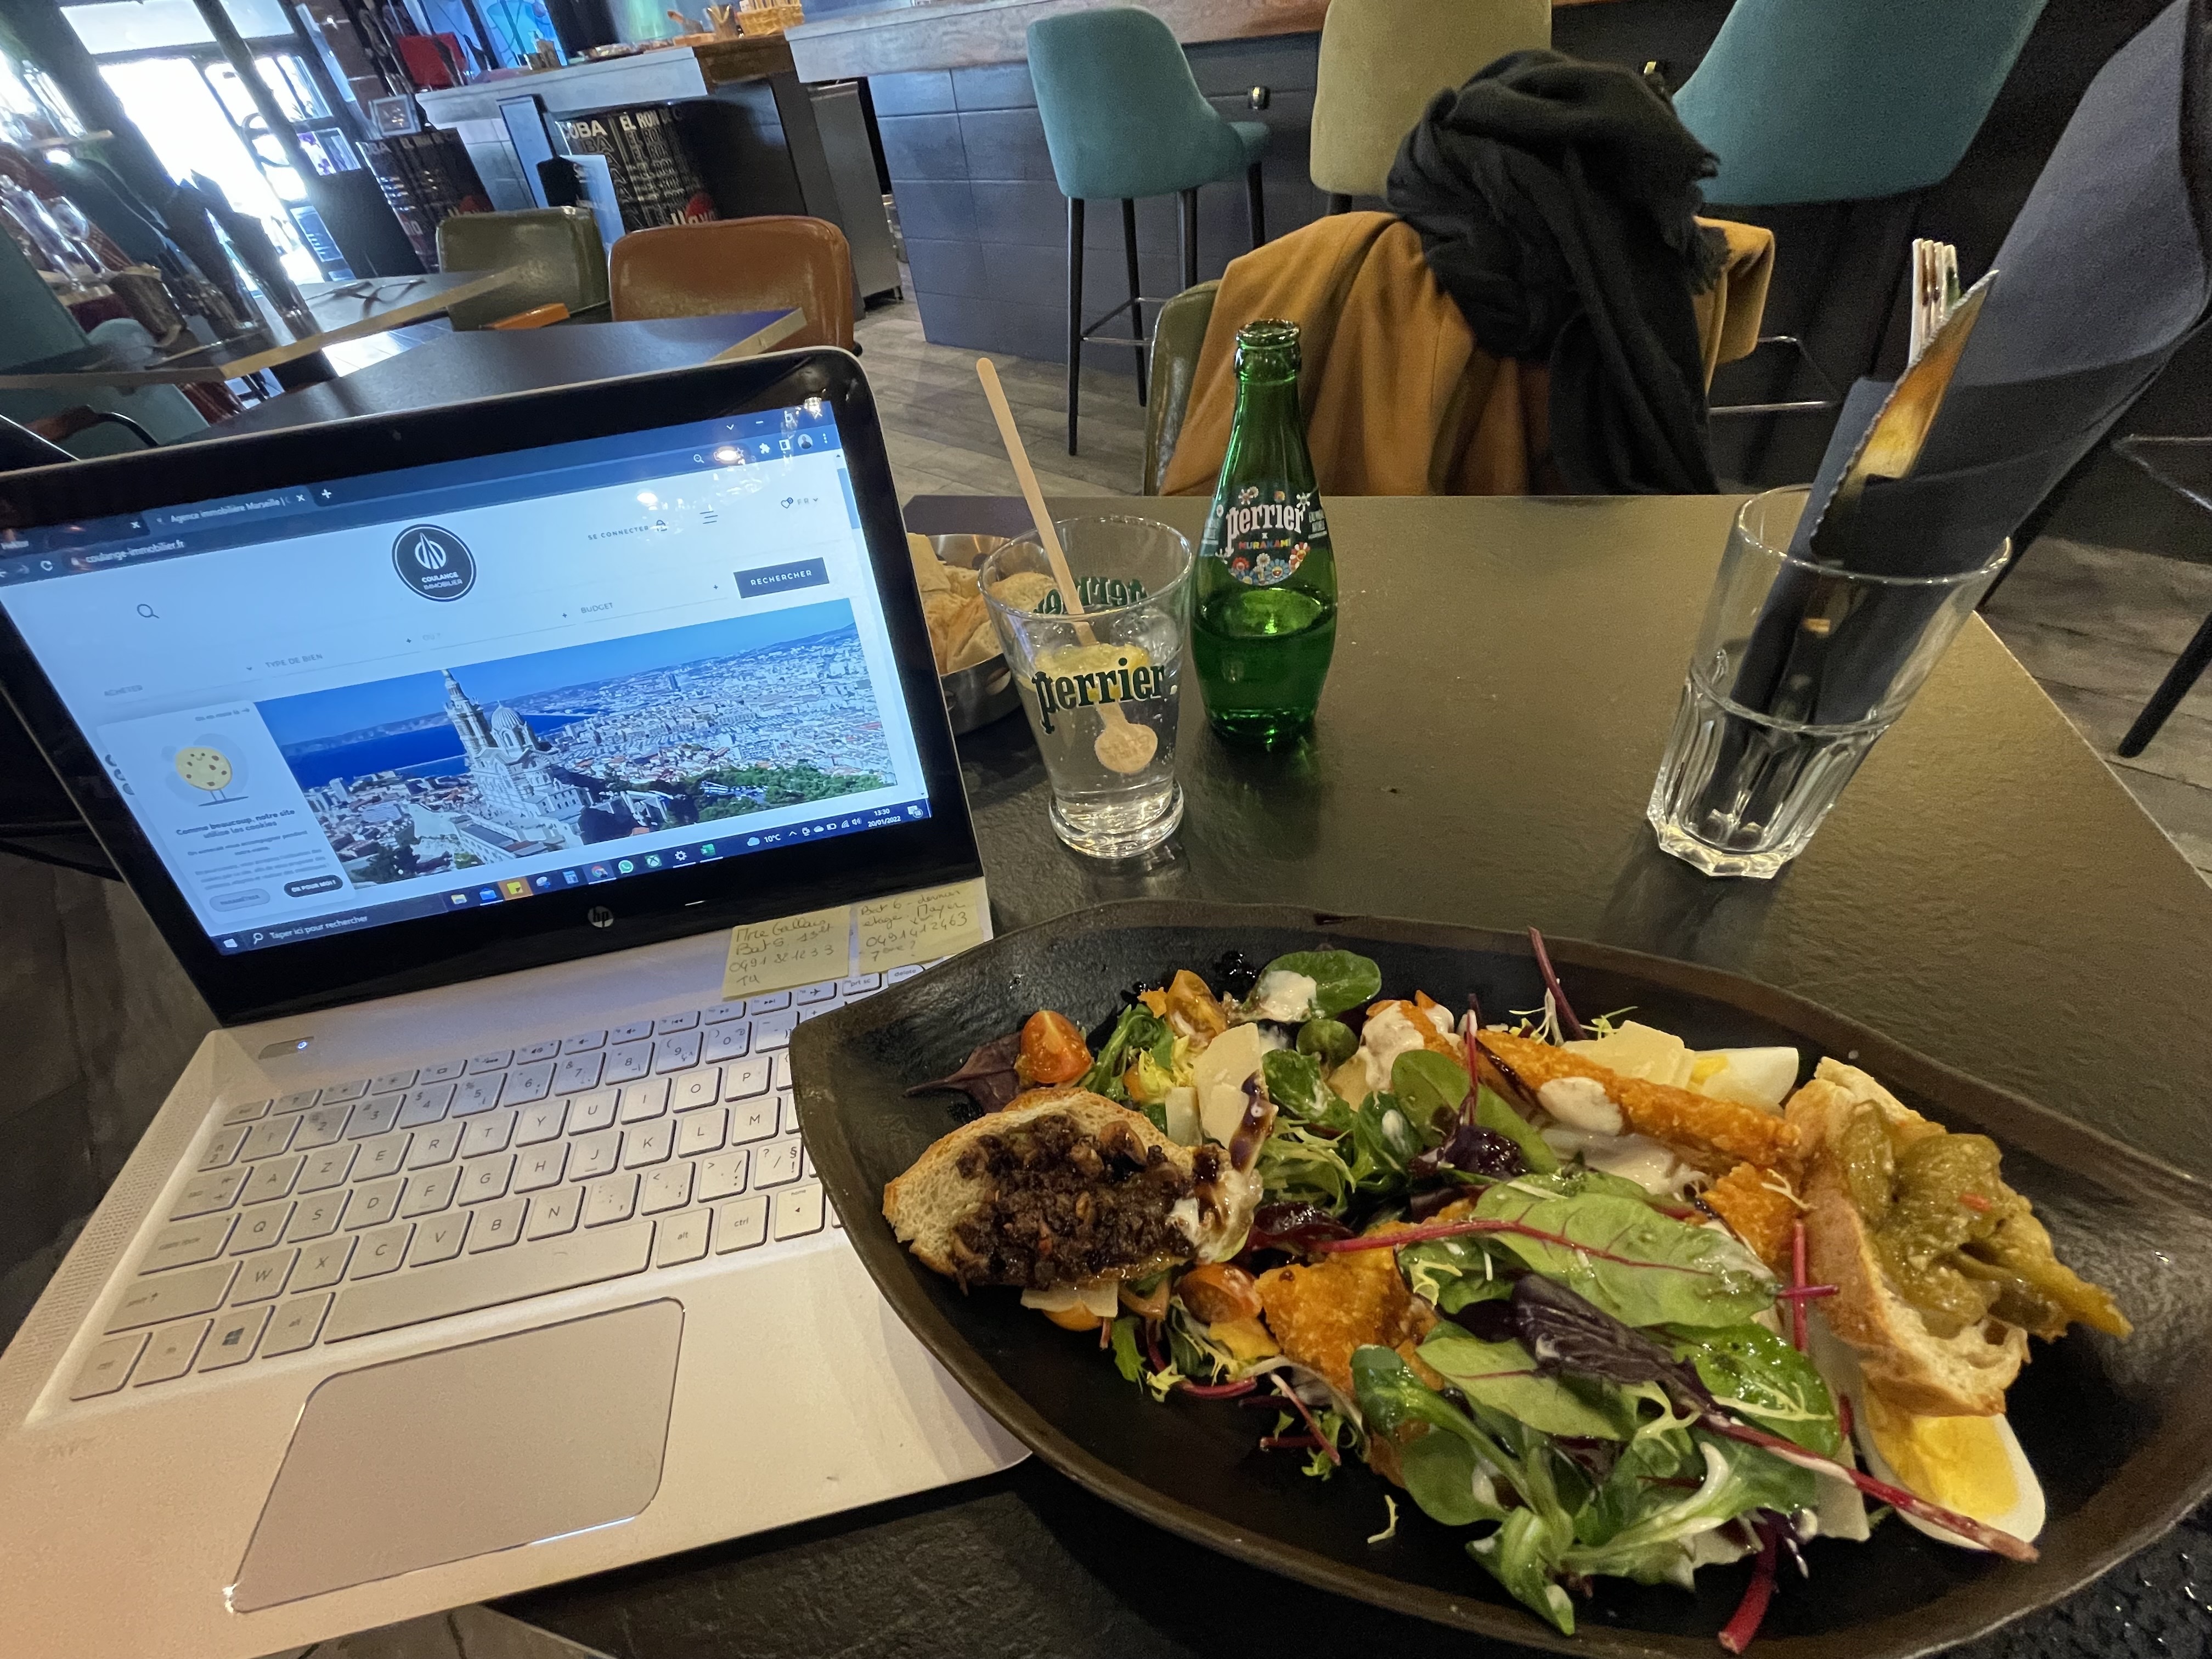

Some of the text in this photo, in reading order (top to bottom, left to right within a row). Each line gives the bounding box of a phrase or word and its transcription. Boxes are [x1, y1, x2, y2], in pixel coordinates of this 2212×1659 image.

[601, 526, 649, 538] CONNECTER
[1226, 504, 1304, 557] perrier
[421, 572, 459, 583] COULANGE
[751, 570, 812, 585] RECHERCHER
[581, 602, 613, 613] BUDGET
[265, 659, 287, 668] TYPE
[301, 654, 323, 663] BIEN
[1032, 658, 1164, 733] perrier
[874, 808, 890, 816] 13:30
[867, 816, 901, 828] 20/01/2022
[270, 929, 293, 939] Taper
[304, 924, 324, 934] pour
[325, 916, 368, 928] rechercher
[894, 968, 916, 977] delete
[675, 1047, 681, 1056] 9
[625, 1057, 633, 1066] 8
[742, 1072, 751, 1082] P
[525, 1079, 533, 1087] 6
[691, 1084, 701, 1093] O
[474, 1089, 481, 1098] 5
[370, 1110, 380, 1120] 3
[588, 1105, 598, 1115] U
[537, 1116, 546, 1127] Y
[749, 1114, 760, 1126] M
[484, 1127, 493, 1137] T
[697, 1127, 704, 1136] L
[428, 1139, 439, 1150] R
[643, 1137, 654, 1148] K
[375, 1150, 387, 1161] E
[590, 1149, 599, 1160] J
[320, 1162, 332, 1172] Z
[534, 1160, 546, 1172] H
[266, 1173, 277, 1183] A
[480, 1173, 491, 1183] G
[424, 1185, 435, 1197] F
[367, 1198, 379, 1209] D
[312, 1209, 323, 1220] S
[549, 1206, 560, 1218] N
[253, 1221, 266, 1232] Q
[491, 1219, 501, 1231] B
[734, 1217, 749, 1227] ctrl
[435, 1231, 446, 1243] V
[678, 1231, 689, 1240] alt
[376, 1244, 387, 1256] C
[315, 1256, 329, 1269] X
[256, 1268, 273, 1282] W
